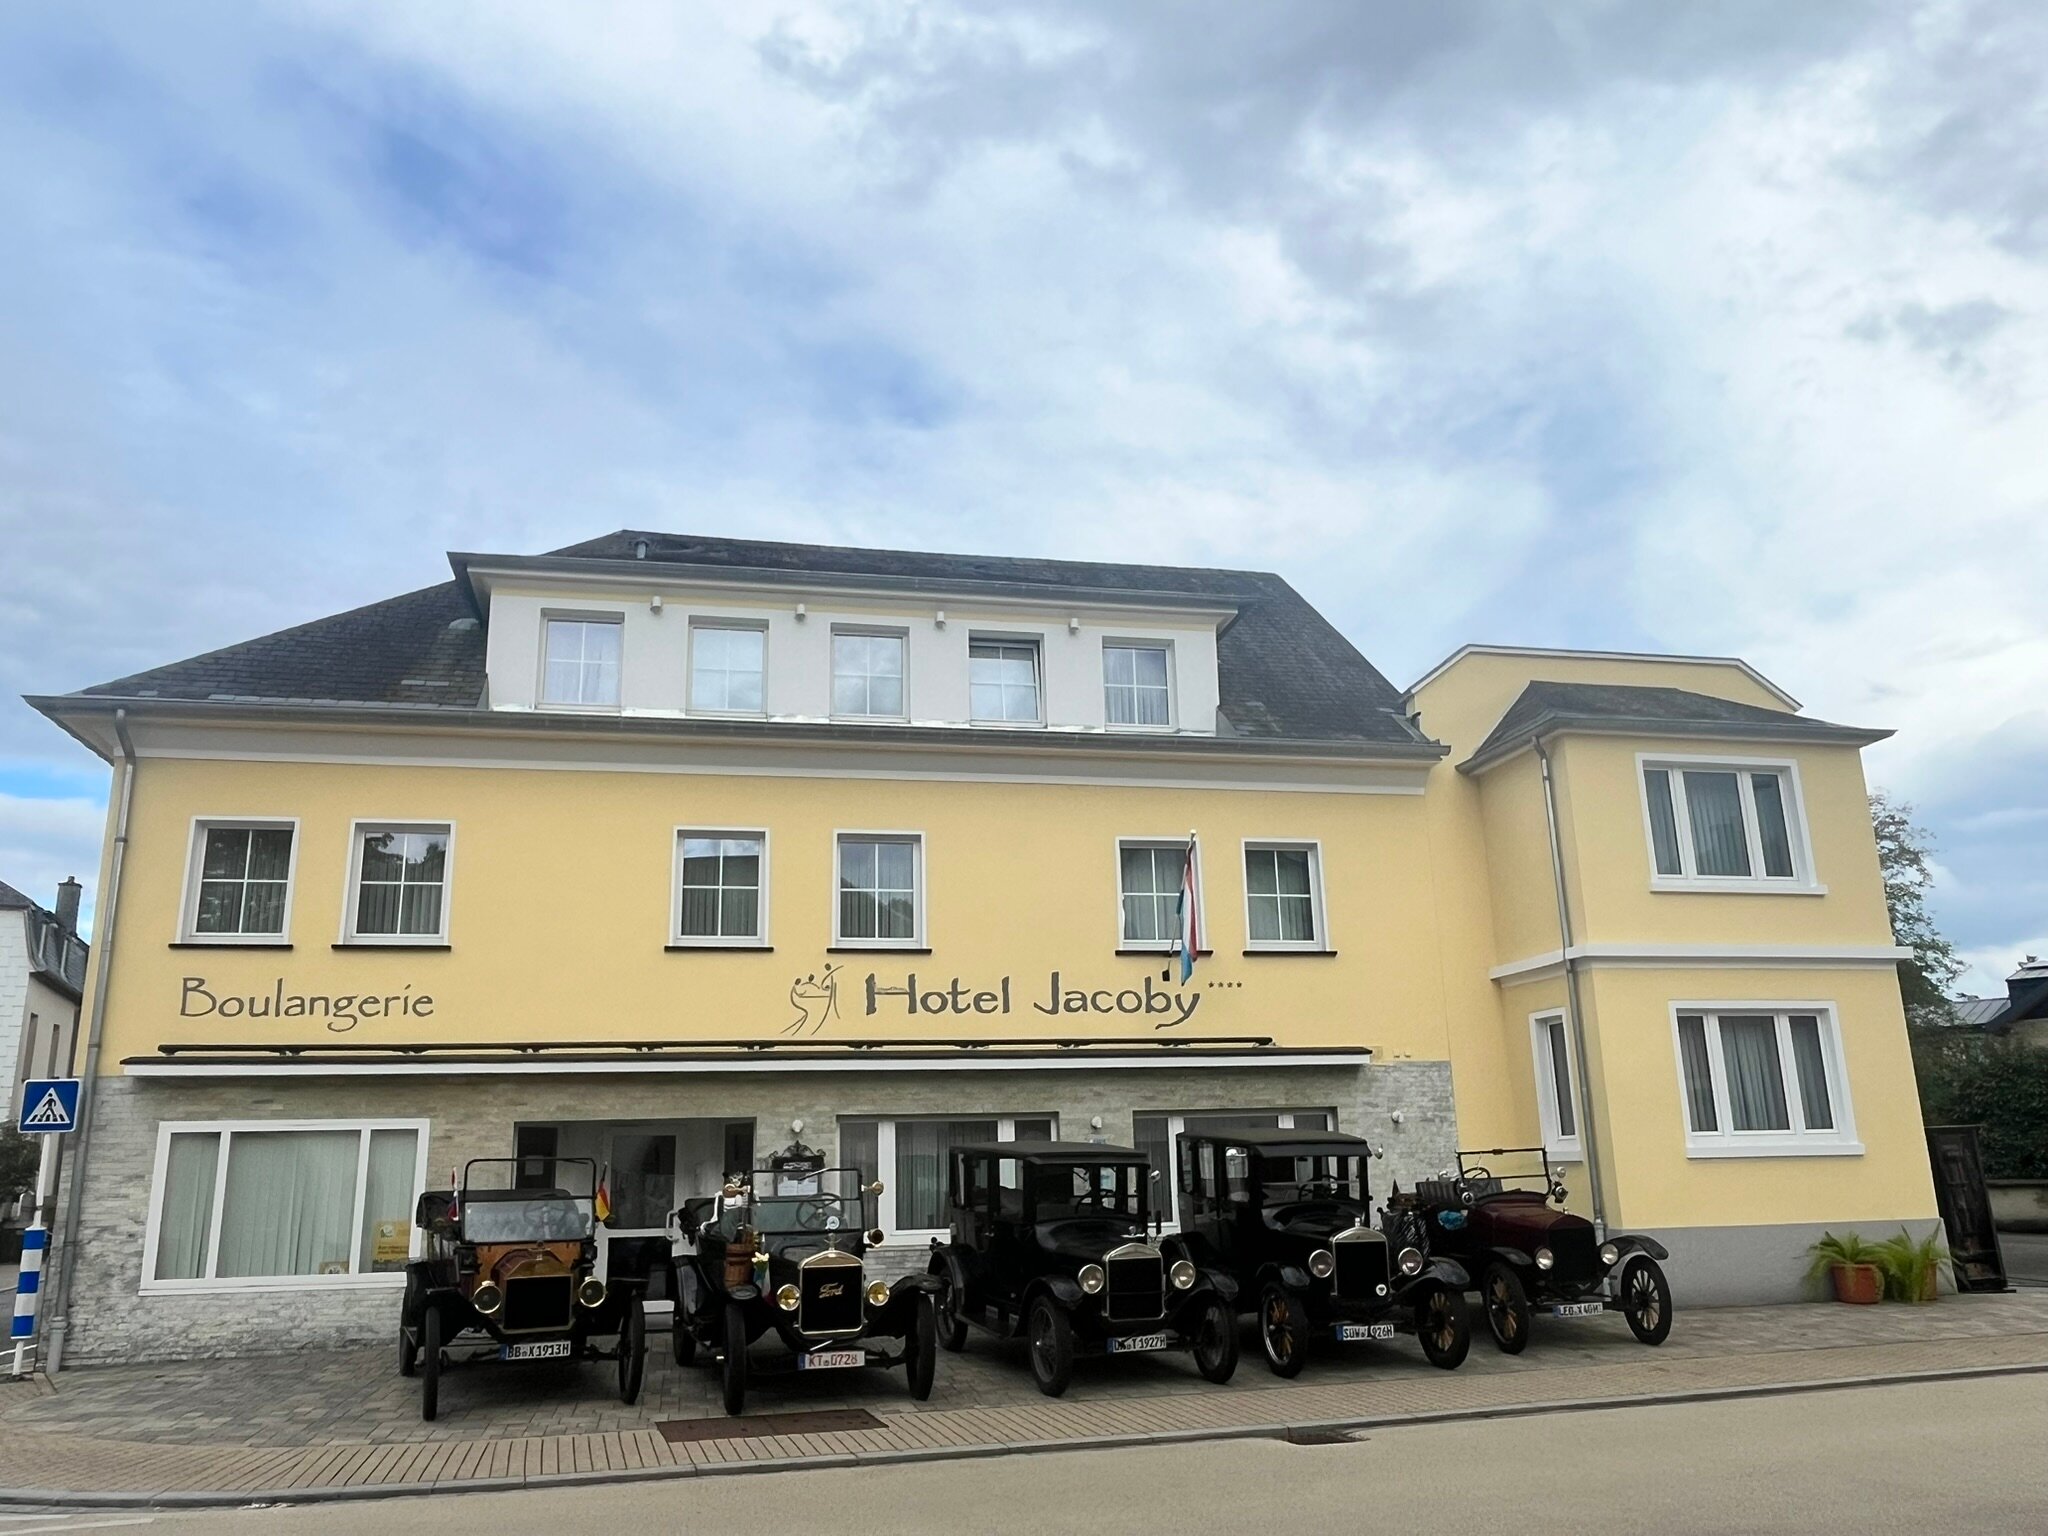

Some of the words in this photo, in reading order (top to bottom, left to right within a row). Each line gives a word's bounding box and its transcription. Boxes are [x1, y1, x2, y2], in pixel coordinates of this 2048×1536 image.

[179, 976, 434, 1033] Boulangerie
[865, 972, 1010, 1015] Hotel
[1033, 971, 1201, 1031] Jacoby
[818, 1282, 845, 1299] Ford
